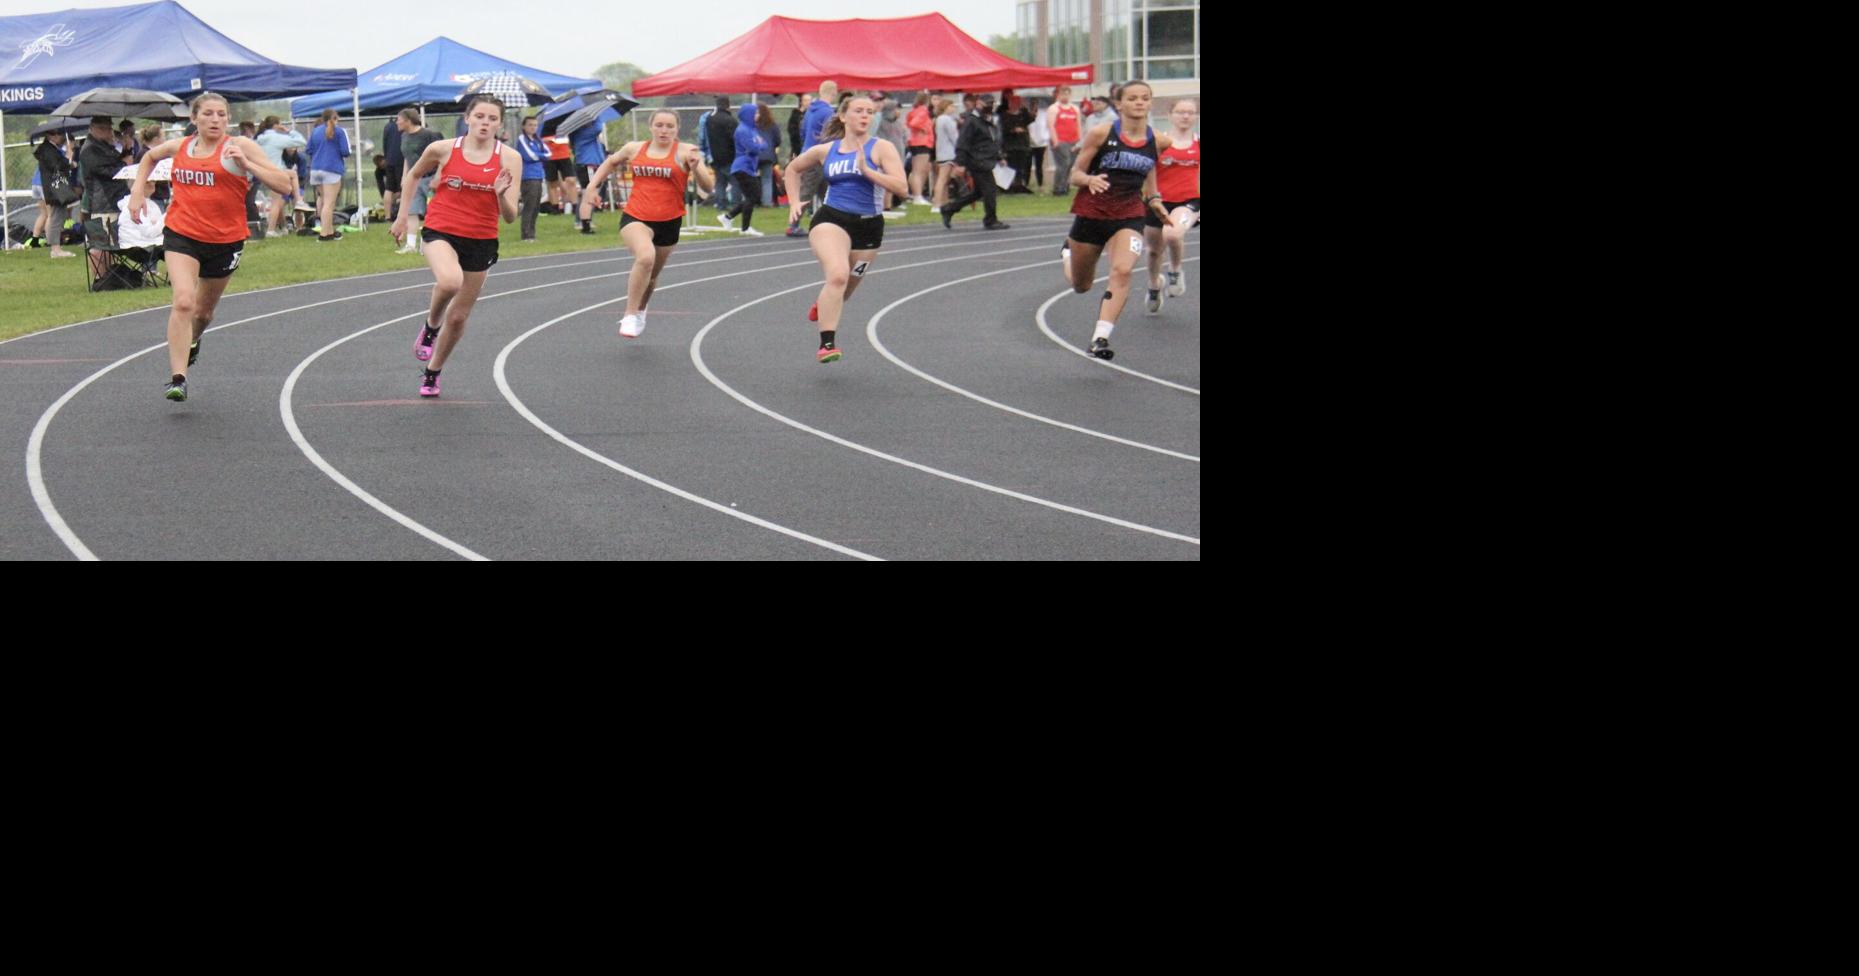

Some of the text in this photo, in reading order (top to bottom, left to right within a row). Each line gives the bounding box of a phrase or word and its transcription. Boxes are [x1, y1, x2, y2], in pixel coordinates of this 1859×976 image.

[174, 168, 215, 186] RIPON
[633, 165, 672, 178] RIPON
[854, 262, 868, 276] 4
